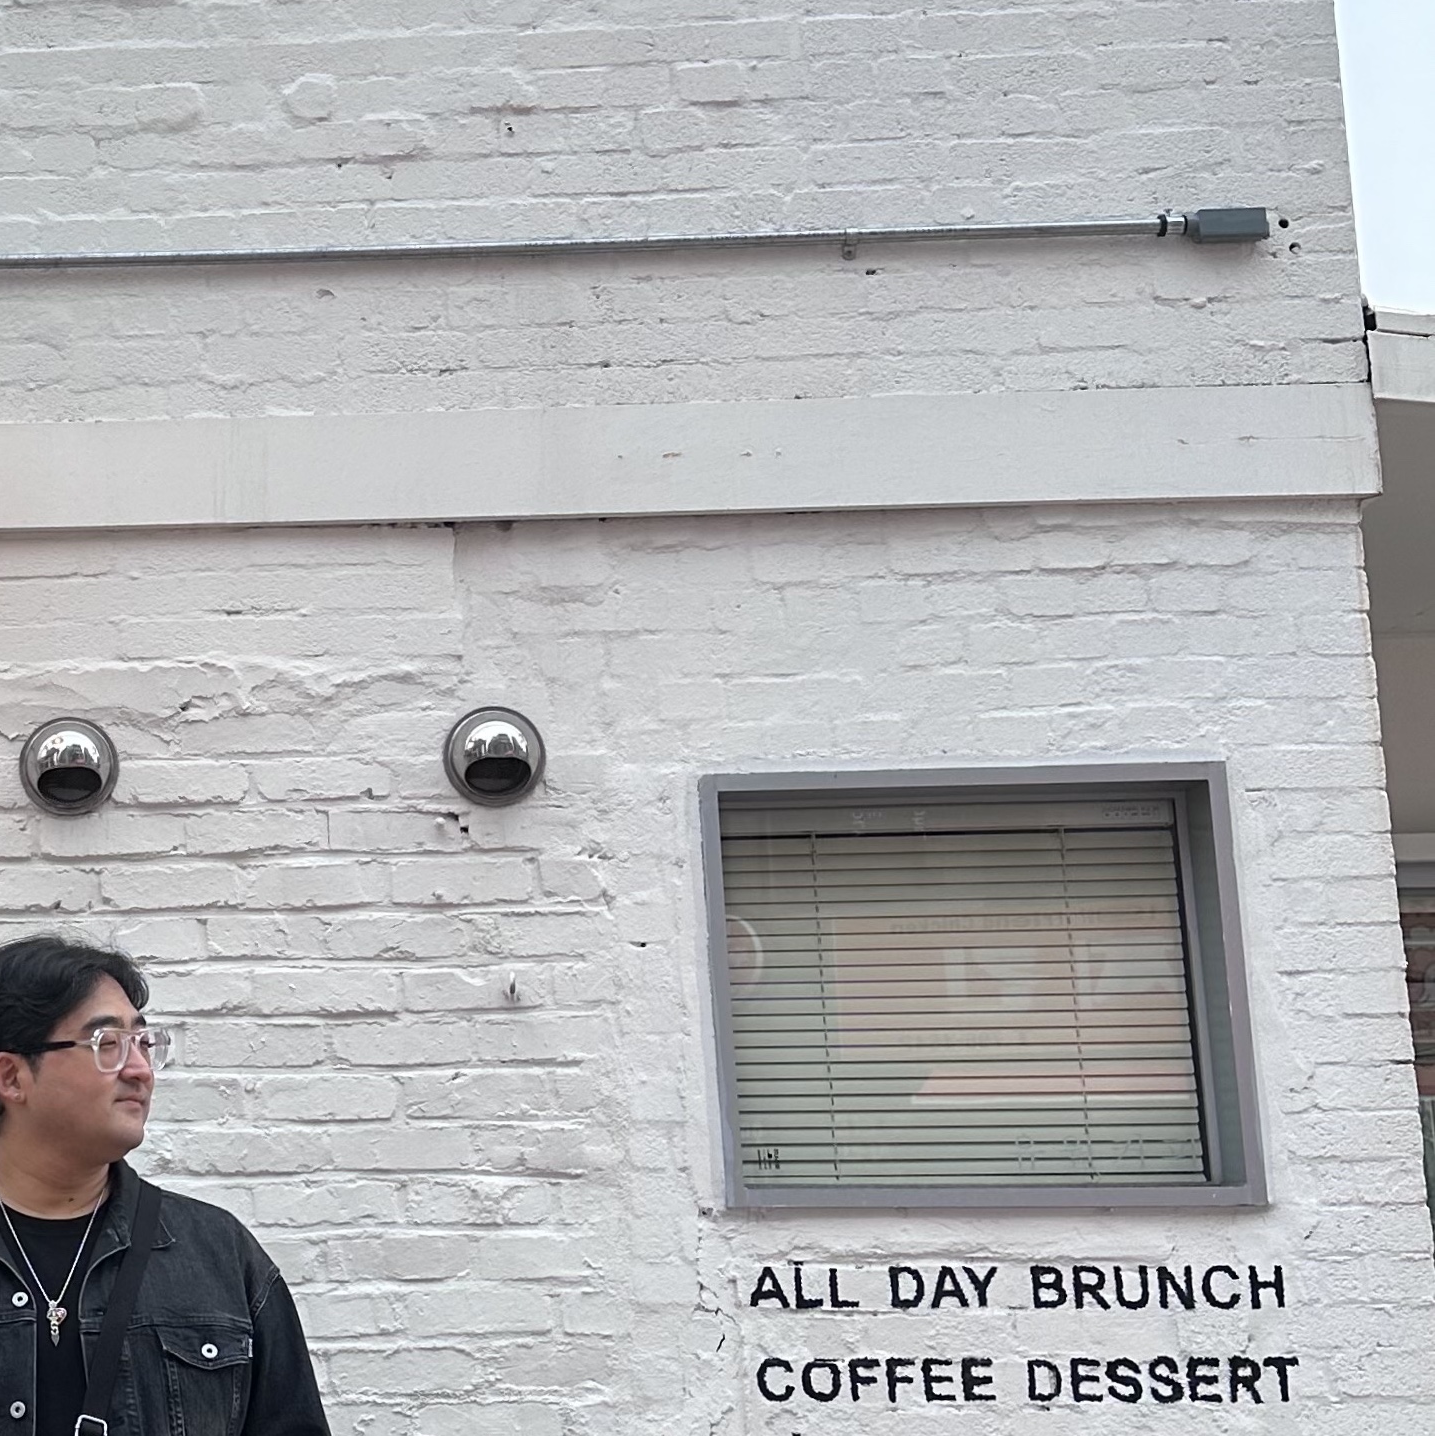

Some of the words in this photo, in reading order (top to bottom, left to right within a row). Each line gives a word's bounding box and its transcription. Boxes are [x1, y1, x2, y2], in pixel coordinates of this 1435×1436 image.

[749, 1266, 860, 1310] ALL
[888, 1265, 998, 1310] DAY
[1029, 1264, 1285, 1311] BRUNCH
[756, 1356, 997, 1404] COFFEE
[1027, 1354, 1299, 1405] DESSERT
